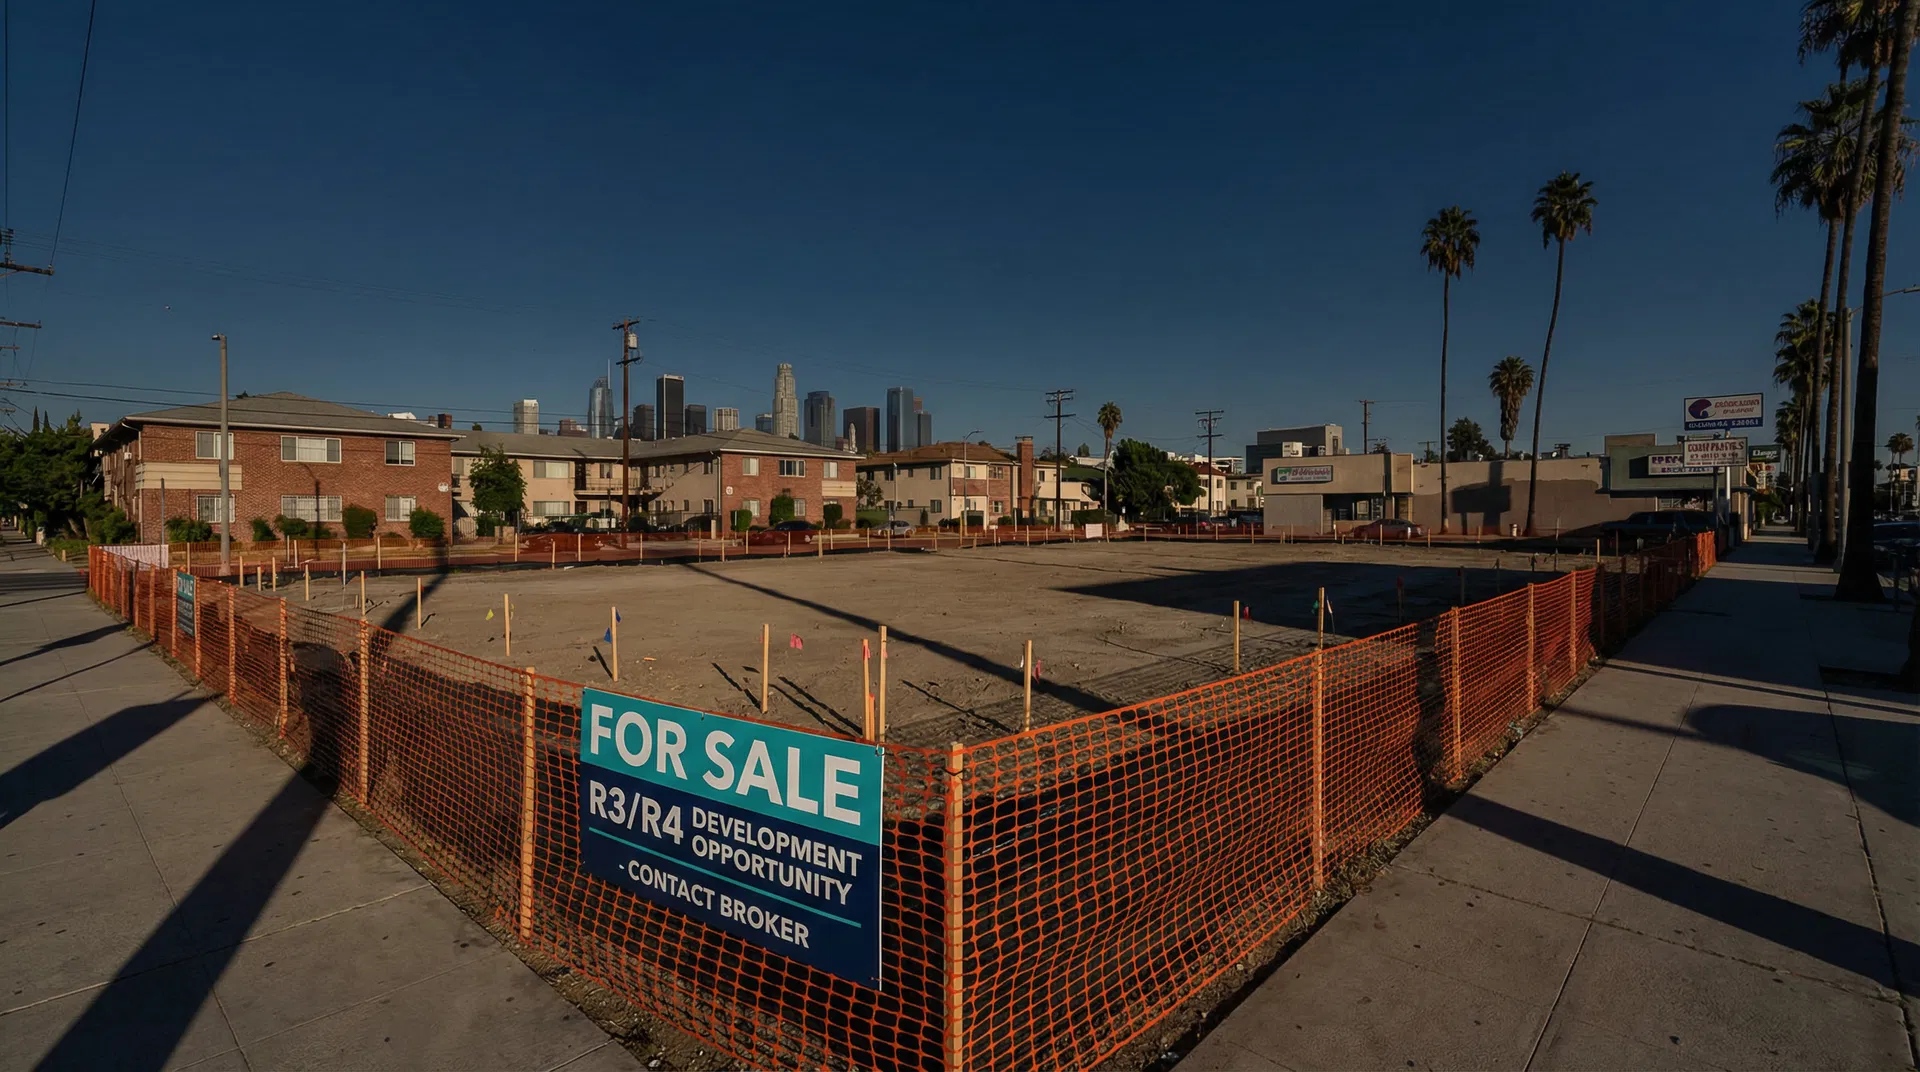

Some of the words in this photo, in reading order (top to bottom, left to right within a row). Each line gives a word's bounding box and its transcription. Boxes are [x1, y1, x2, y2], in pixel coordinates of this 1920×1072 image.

[590, 703, 688, 780] FOR
[701, 729, 862, 827] SALE
[589, 780, 684, 845] R3/R4
[692, 807, 863, 877] DEVELOPMENT
[691, 835, 853, 906] OPPORTUNITY
[628, 859, 715, 910] CONTACT
[720, 898, 810, 949] BROKER
